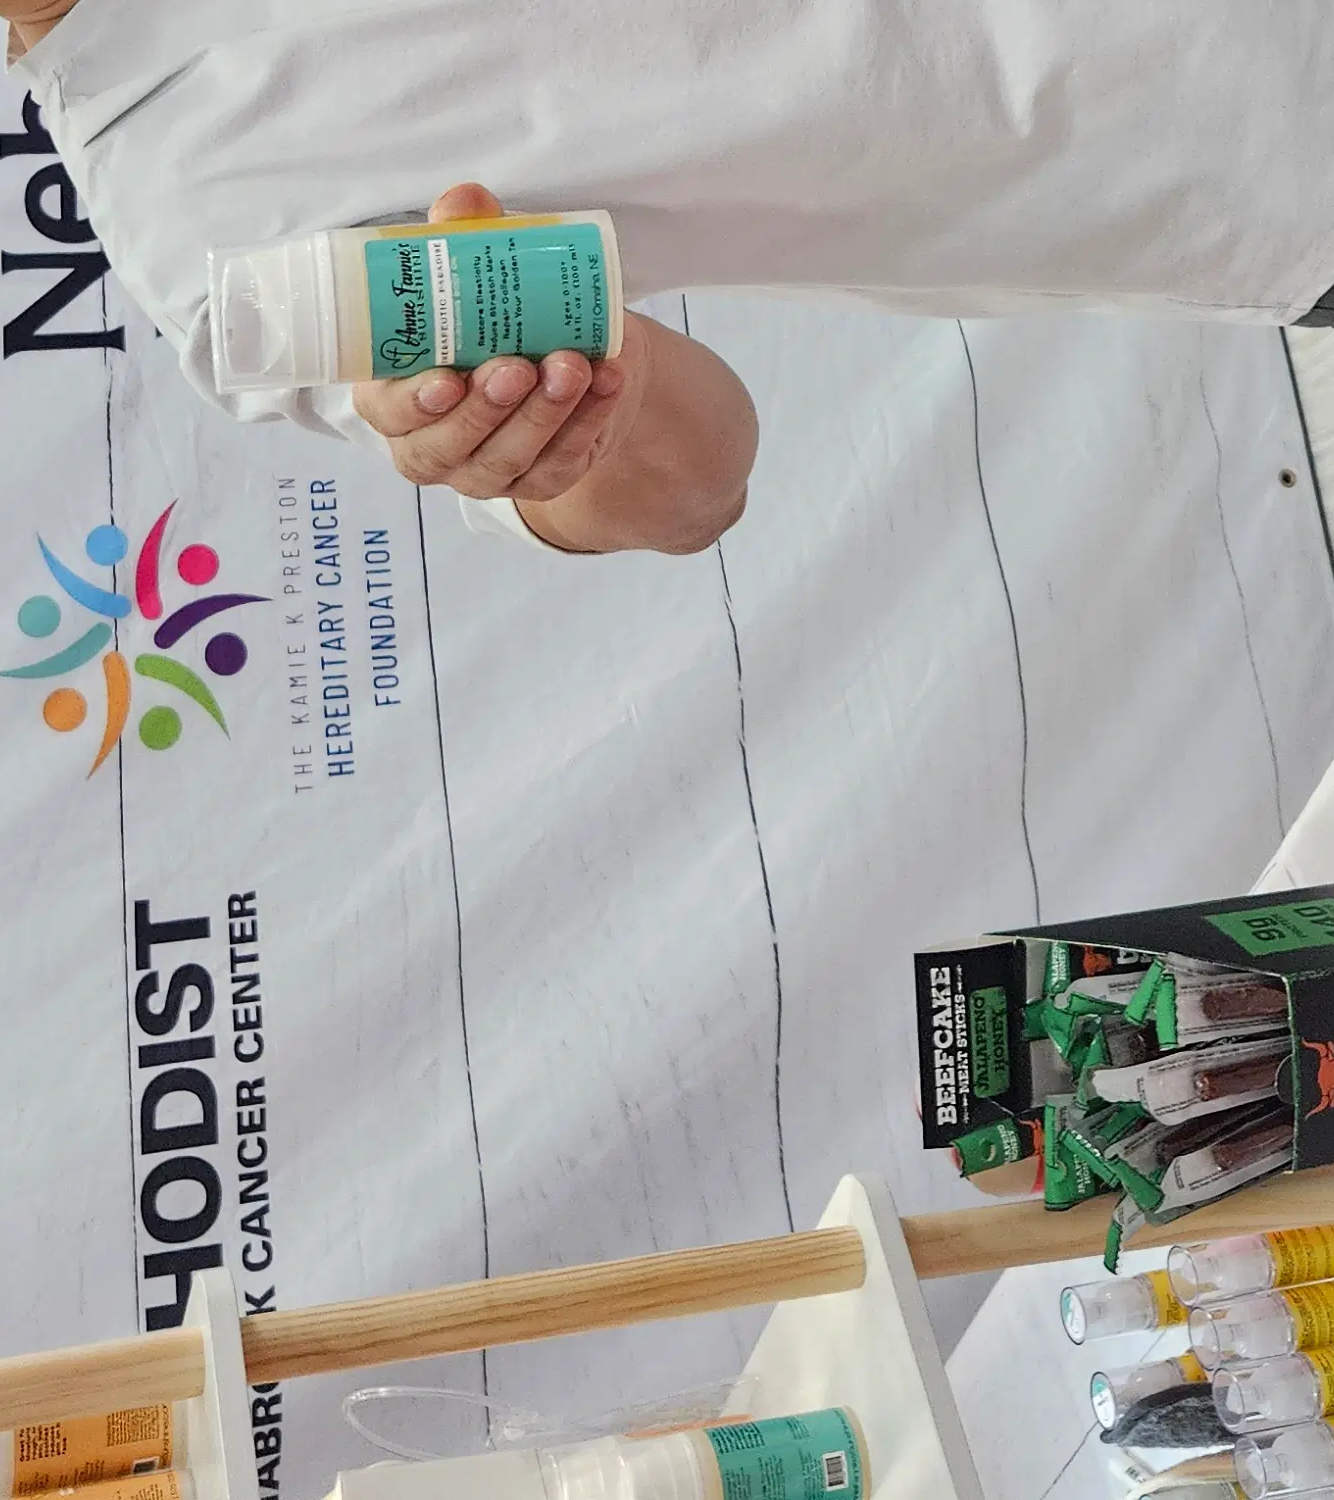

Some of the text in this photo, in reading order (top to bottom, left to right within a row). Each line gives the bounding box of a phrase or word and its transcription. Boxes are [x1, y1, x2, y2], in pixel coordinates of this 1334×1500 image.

[391, 242, 421, 347] Annie Fannie's
[473, 255, 486, 347] Restore Elasticity
[485, 245, 494, 272] Marks
[487, 275, 497, 317] Stretch
[499, 259, 512, 340] Repair Collagen
[510, 255, 521, 291] Golden
[514, 295, 523, 318] Your
[587, 253, 598, 270] NE
[277, 476, 314, 794] THE KAMIE K PRESTON
[309, 478, 355, 777] HEREDITARY CANCER
[363, 528, 401, 707] FOUNDATION
[227, 890, 263, 1064] CENTER
[930, 966, 957, 1126] BEEFCAKE
[954, 993, 969, 1094] MEAT STICKS
[992, 1007, 1006, 1072] HONEY
[133, 899, 223, 1331] HODIST
[237, 1076, 274, 1271] CANCER
